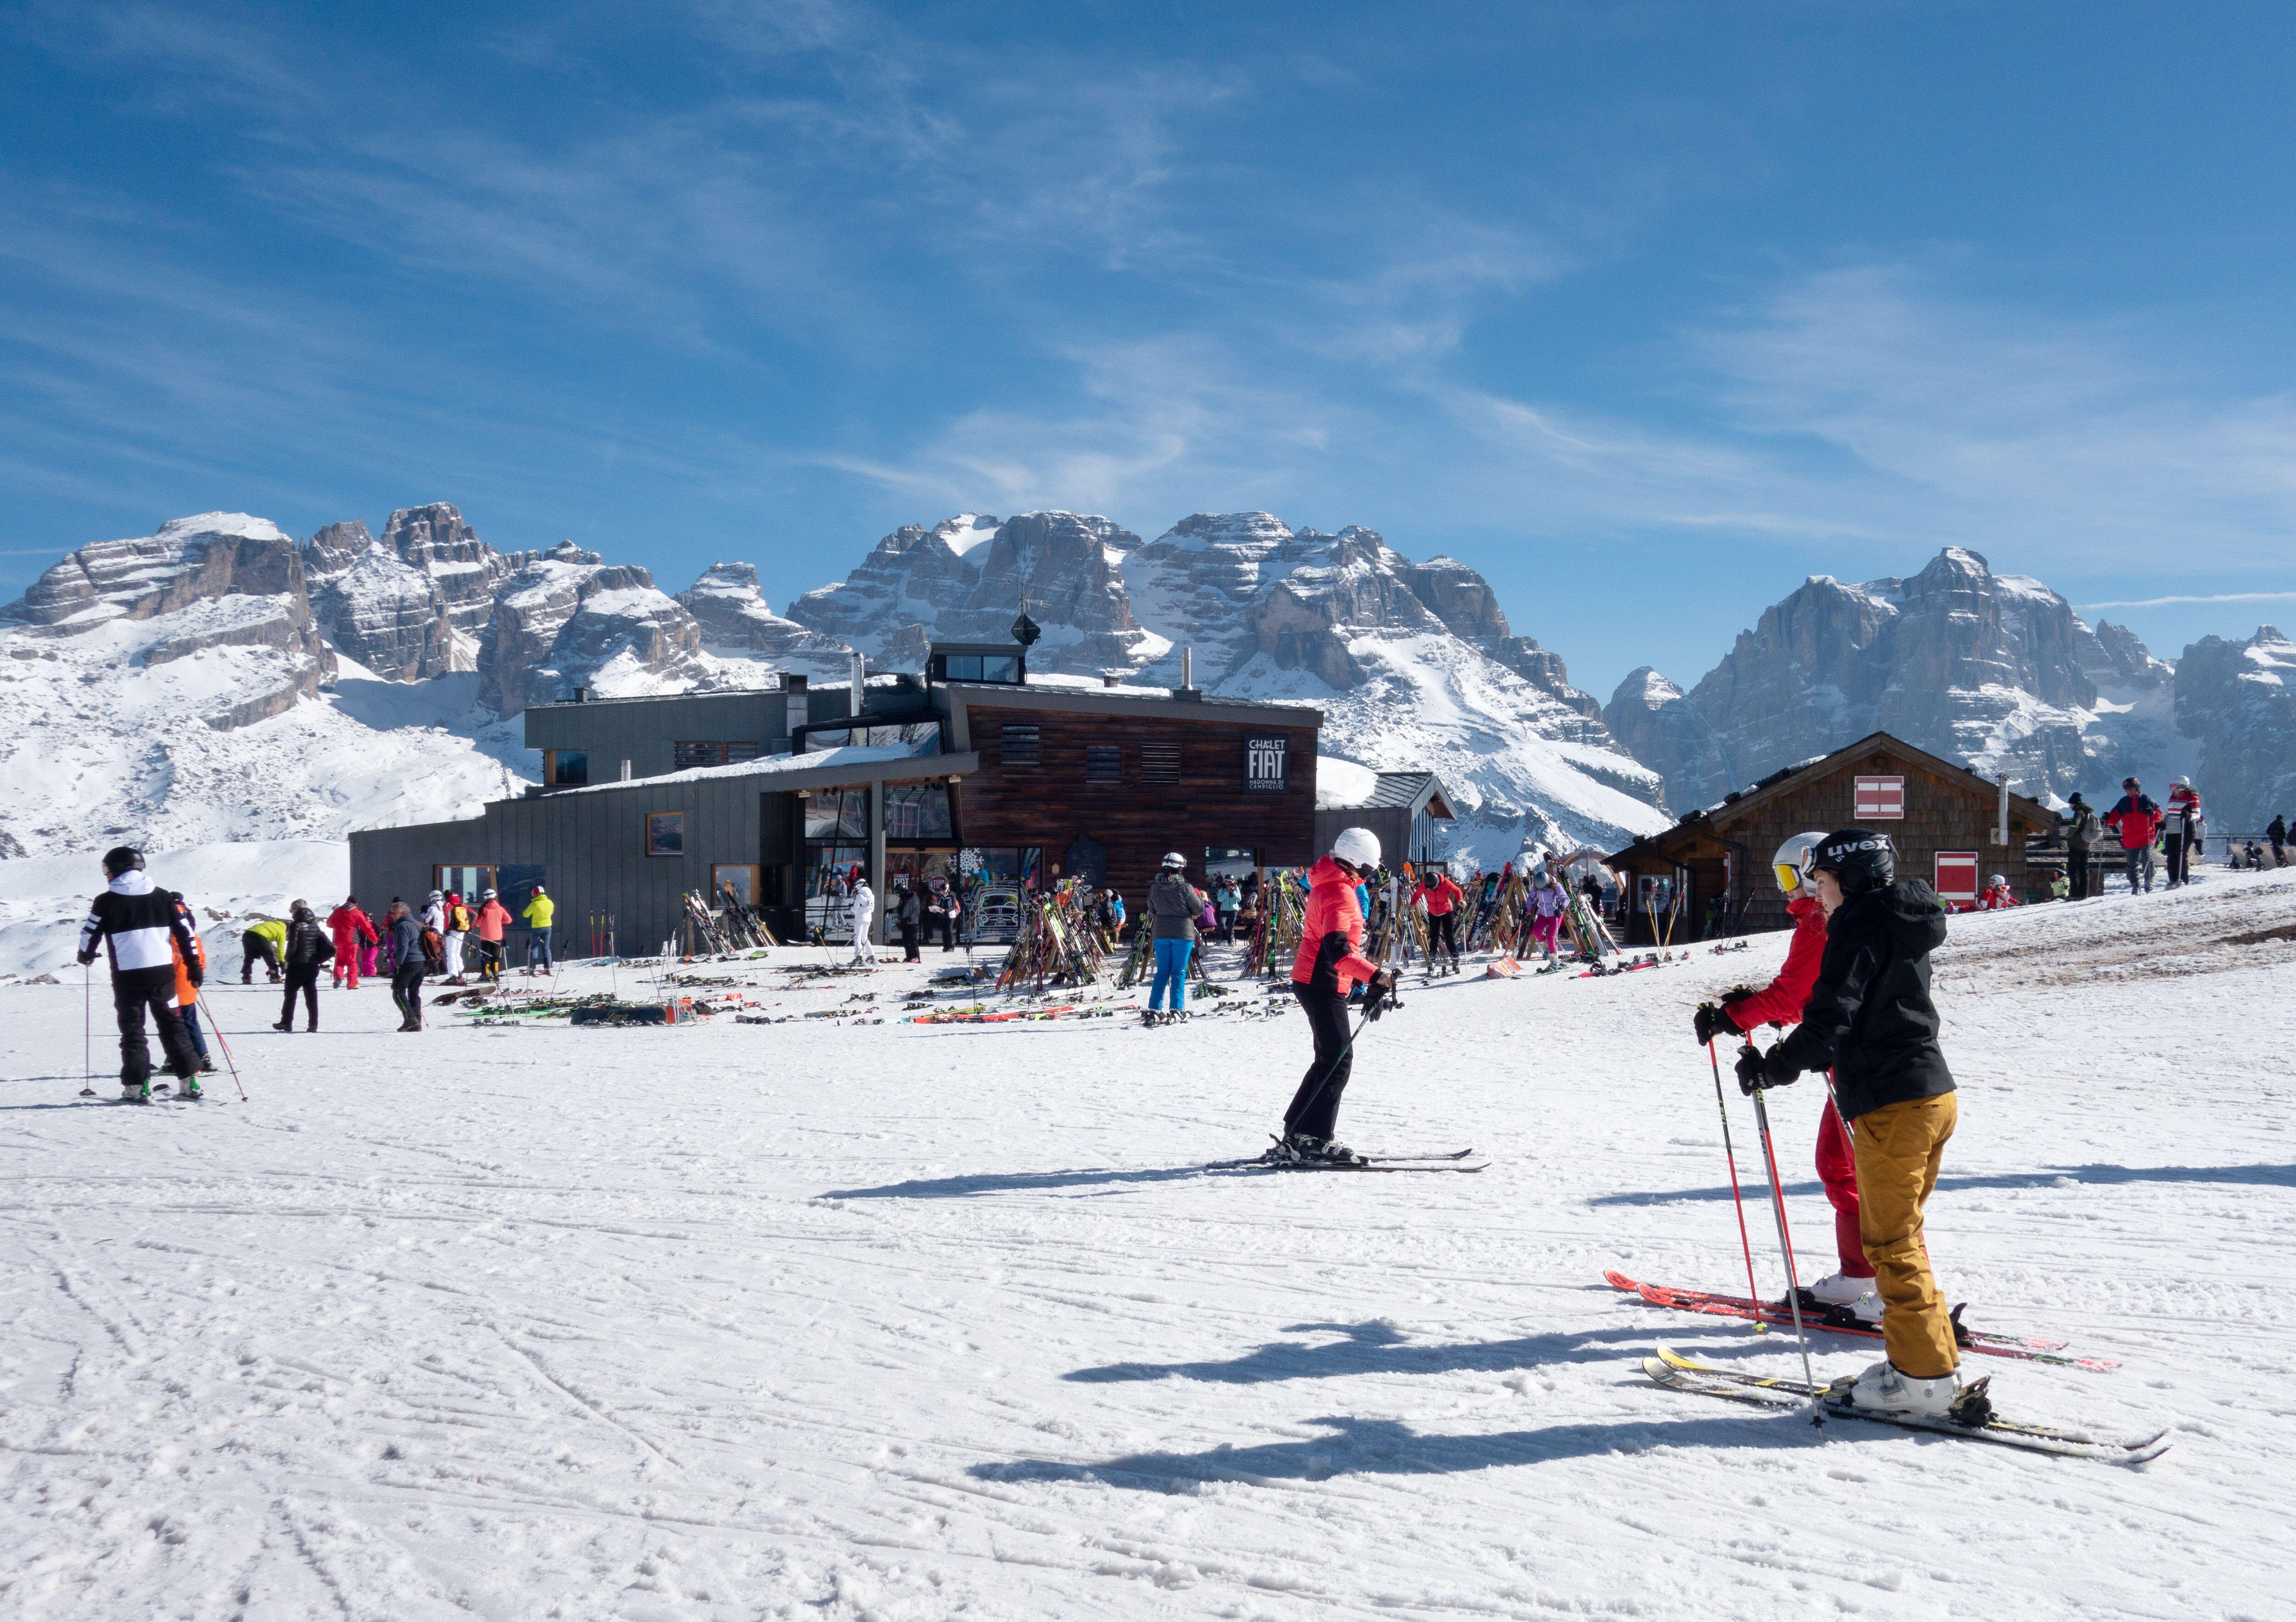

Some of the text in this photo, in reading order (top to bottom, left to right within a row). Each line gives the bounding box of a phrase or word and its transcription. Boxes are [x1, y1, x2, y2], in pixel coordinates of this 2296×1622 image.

[1249, 740, 1285, 749] CHALET
[1249, 750, 1285, 778] FIAT
[1828, 839, 1889, 856] uvex
